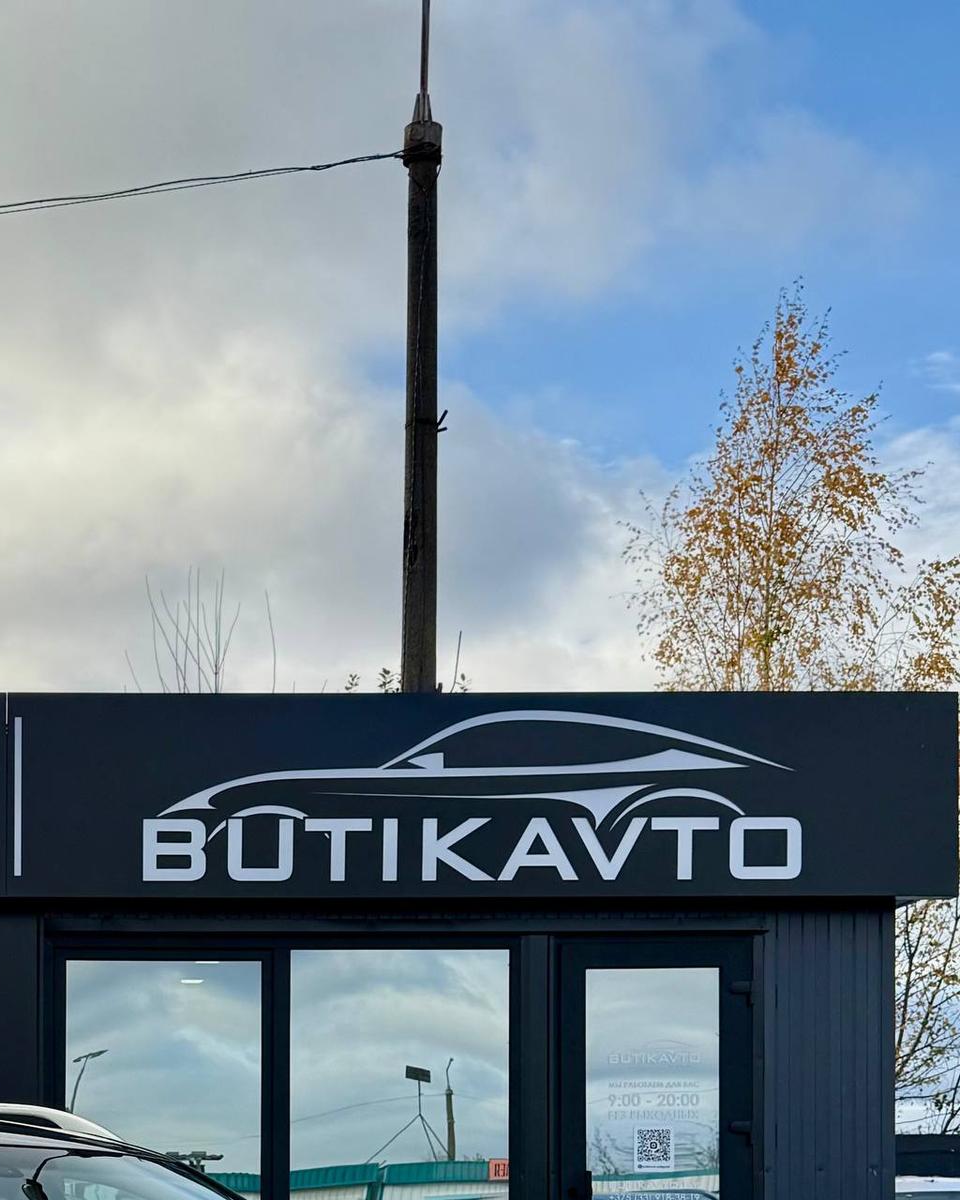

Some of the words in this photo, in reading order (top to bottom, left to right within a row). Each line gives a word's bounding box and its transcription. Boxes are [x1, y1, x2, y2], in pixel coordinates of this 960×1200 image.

[142, 816, 802, 881] BUTIKAVTO
[608, 1094, 641, 1107] 9:00
[657, 1094, 700, 1107] 20:00
